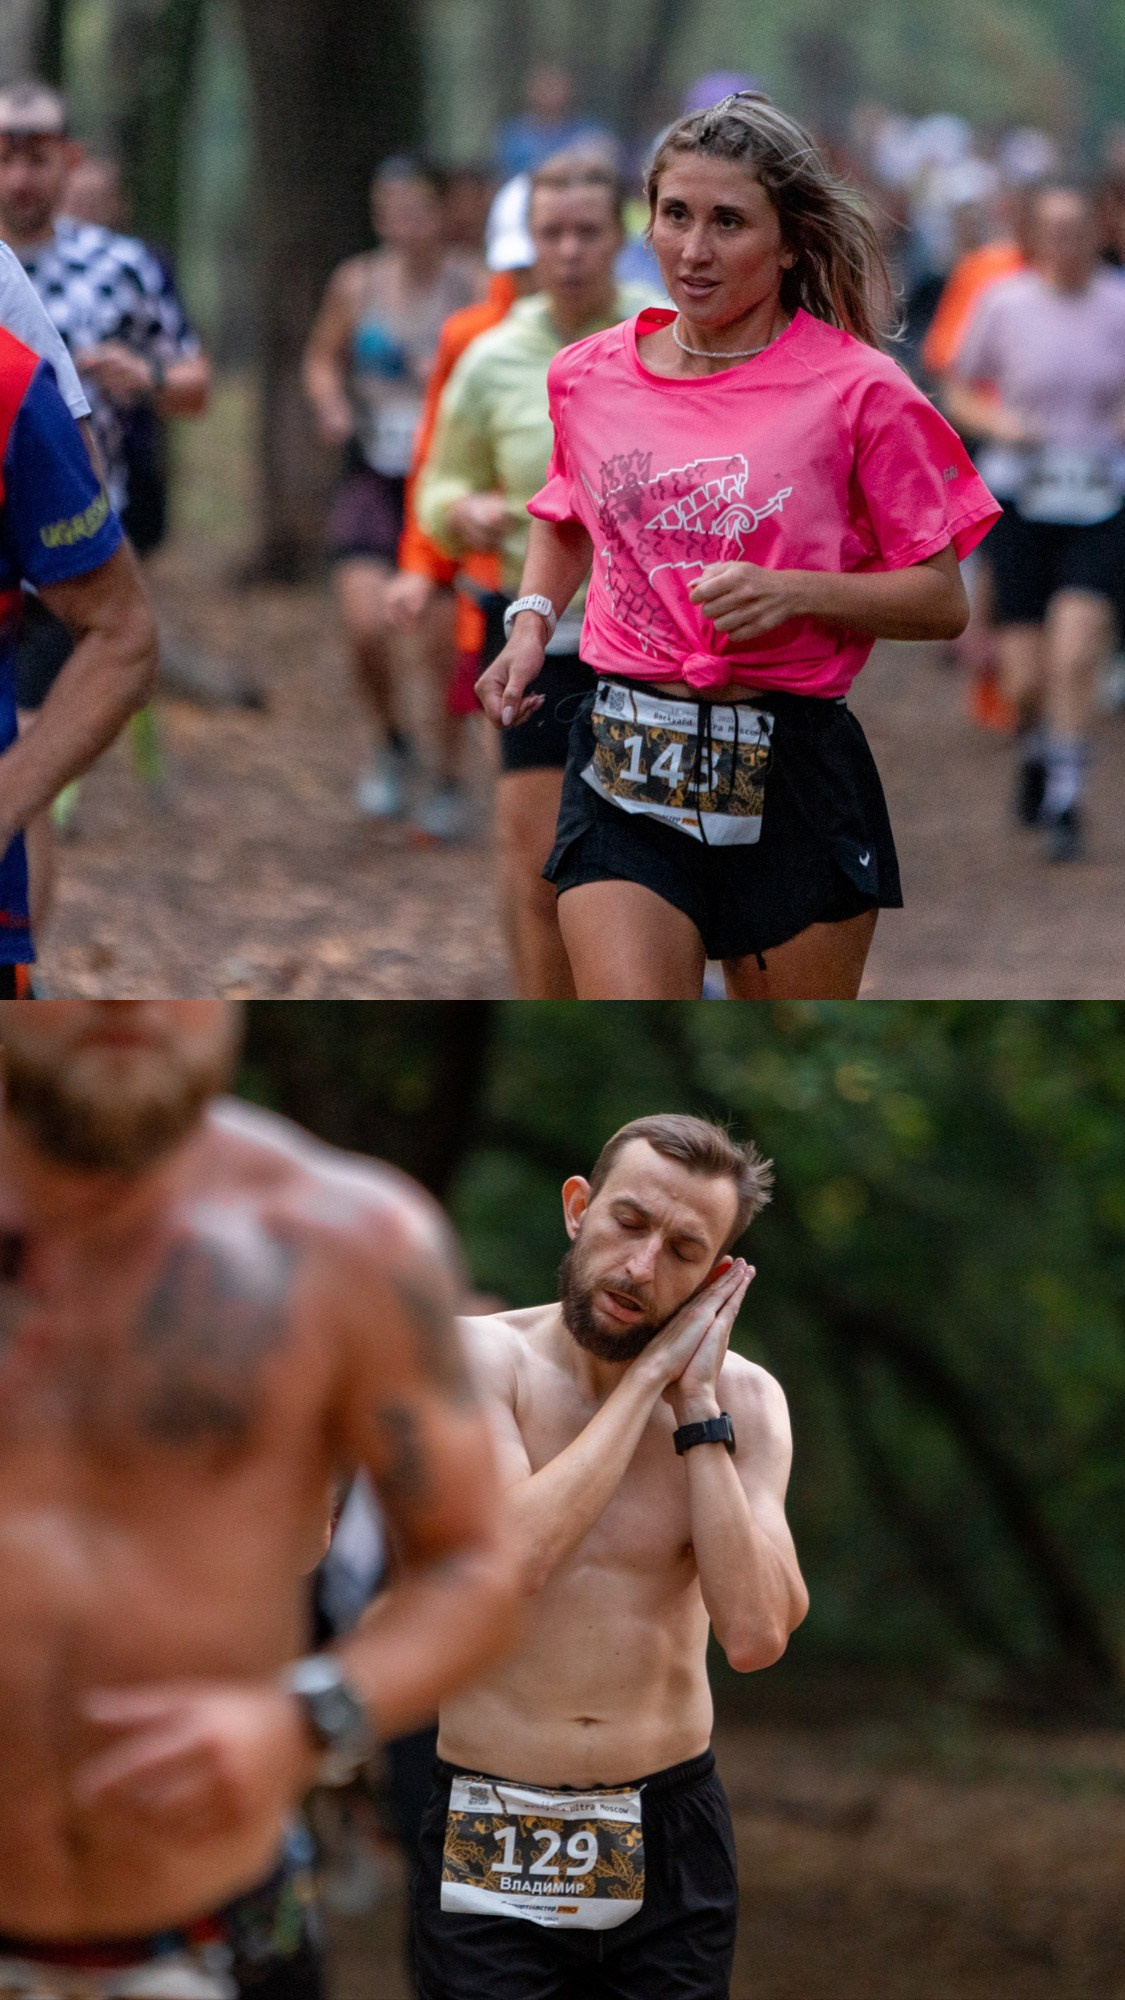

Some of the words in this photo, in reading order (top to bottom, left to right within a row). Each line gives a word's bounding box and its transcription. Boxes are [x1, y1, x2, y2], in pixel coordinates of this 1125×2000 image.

[653, 711, 693, 726] Backyard
[728, 724, 761, 737] Mscow
[619, 735, 719, 793] 143
[569, 1803, 596, 1813] Ultra
[599, 1803, 629, 1814] Moscow
[491, 1826, 599, 1876] 129
[557, 1905, 579, 1914] PRO
